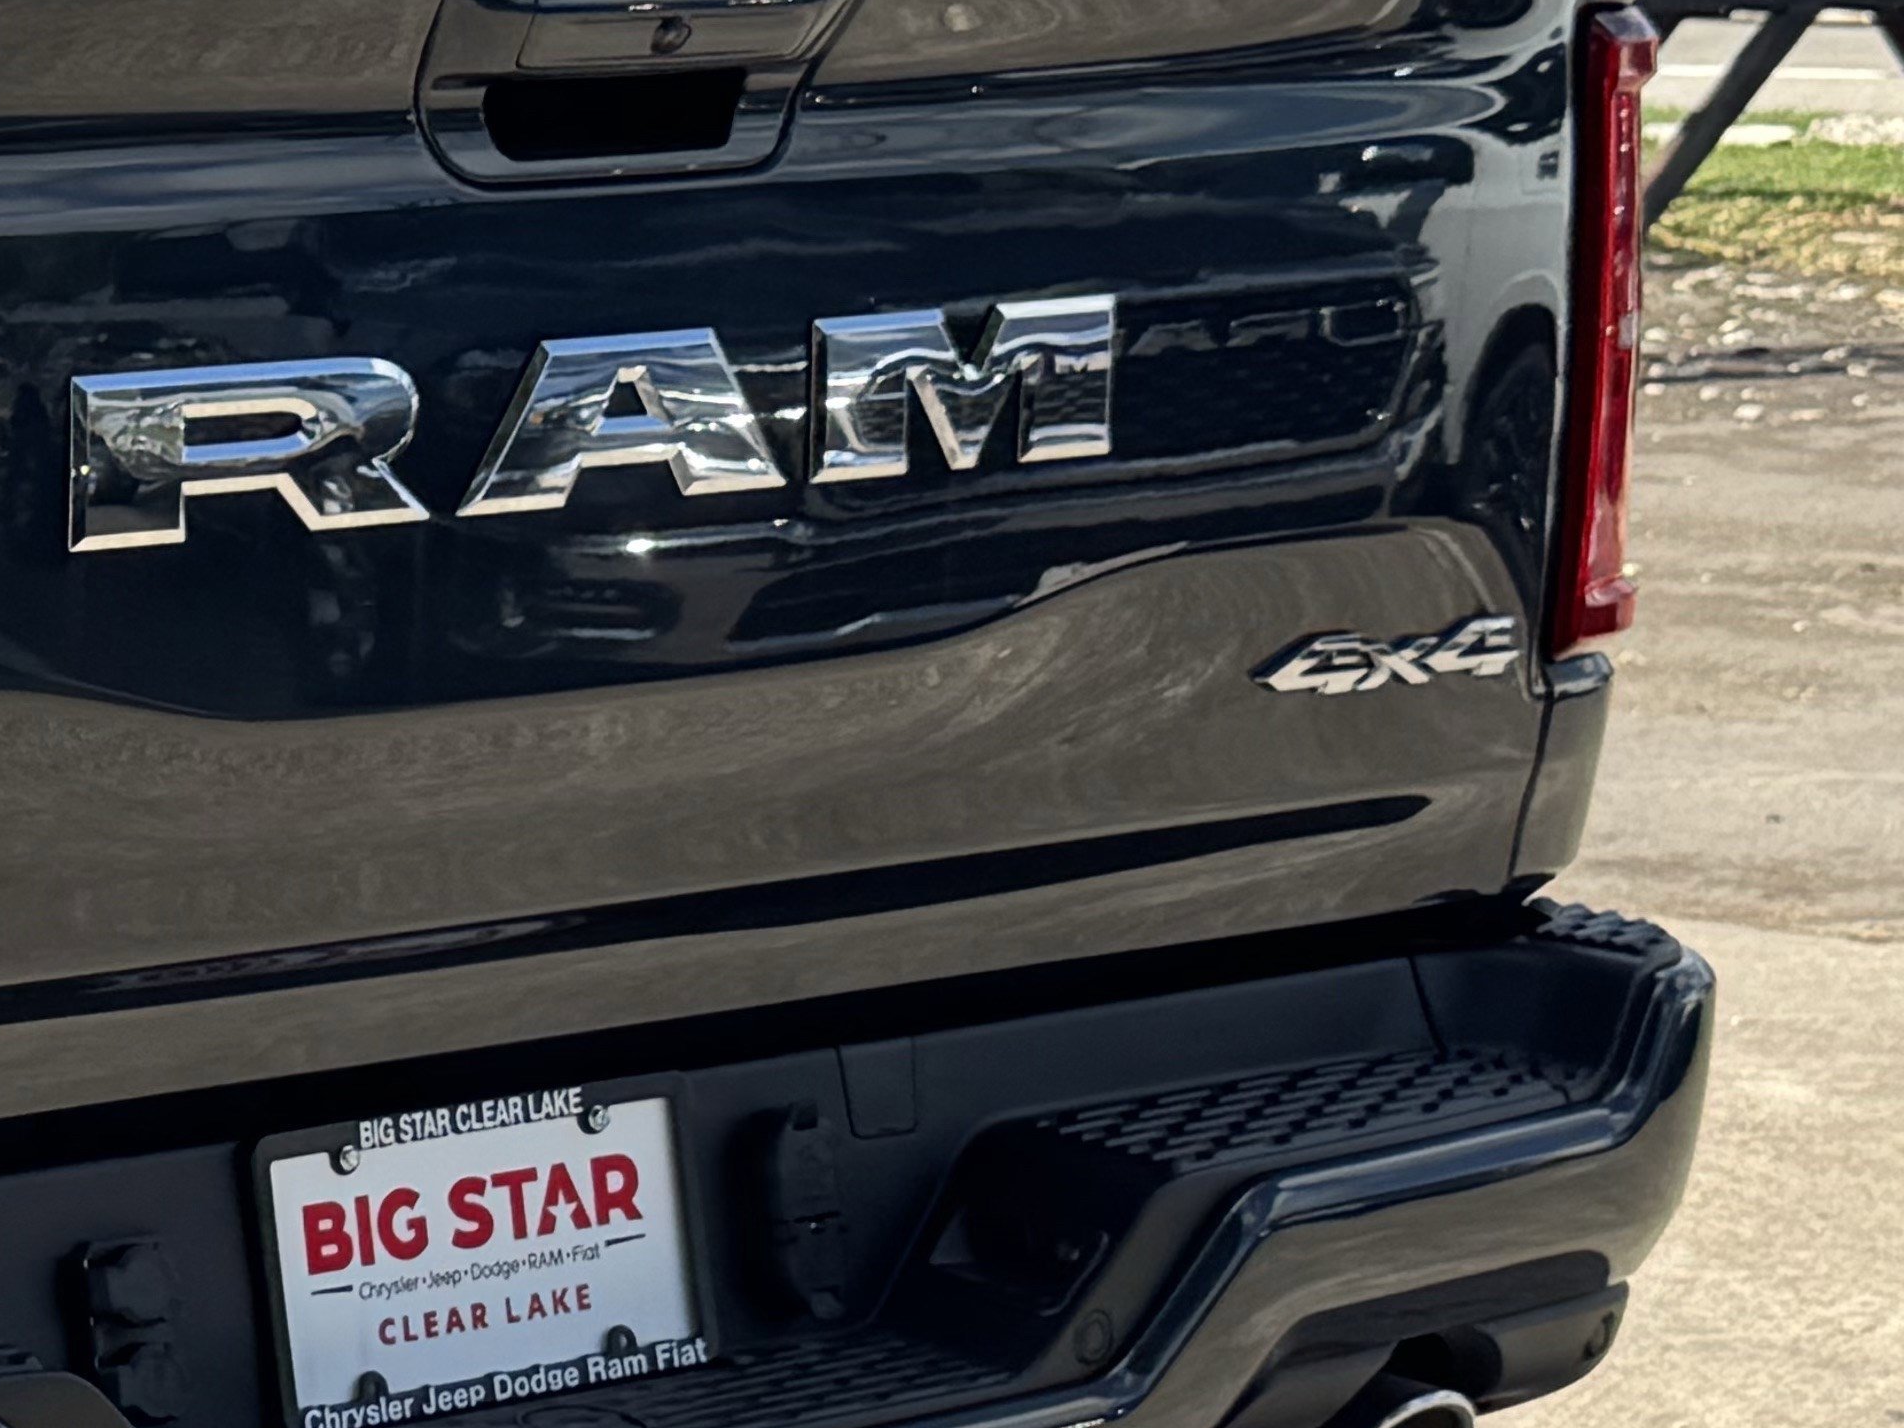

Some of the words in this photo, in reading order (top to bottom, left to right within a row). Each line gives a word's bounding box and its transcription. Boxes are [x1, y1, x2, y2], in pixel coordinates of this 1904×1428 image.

[68, 294, 1116, 553] RAM
[360, 1119, 395, 1149] BIG
[399, 1108, 452, 1143] STAR
[455, 1095, 524, 1133] CLEAR
[528, 1086, 584, 1121] LAKE
[302, 1187, 429, 1275] BIG
[448, 1154, 644, 1249] STAR
[359, 1274, 419, 1300] Chrysler
[428, 1268, 462, 1288] Jeep
[470, 1258, 520, 1281] Dodge
[528, 1248, 565, 1270] RAM
[572, 1243, 601, 1263] Fiat
[378, 1302, 489, 1346] CLEAR
[505, 1283, 592, 1324] LAKE
[423, 1382, 487, 1416] Jeep
[493, 1362, 580, 1402] Dodge
[587, 1352, 648, 1384] Ram
[656, 1337, 709, 1371] Fiat
